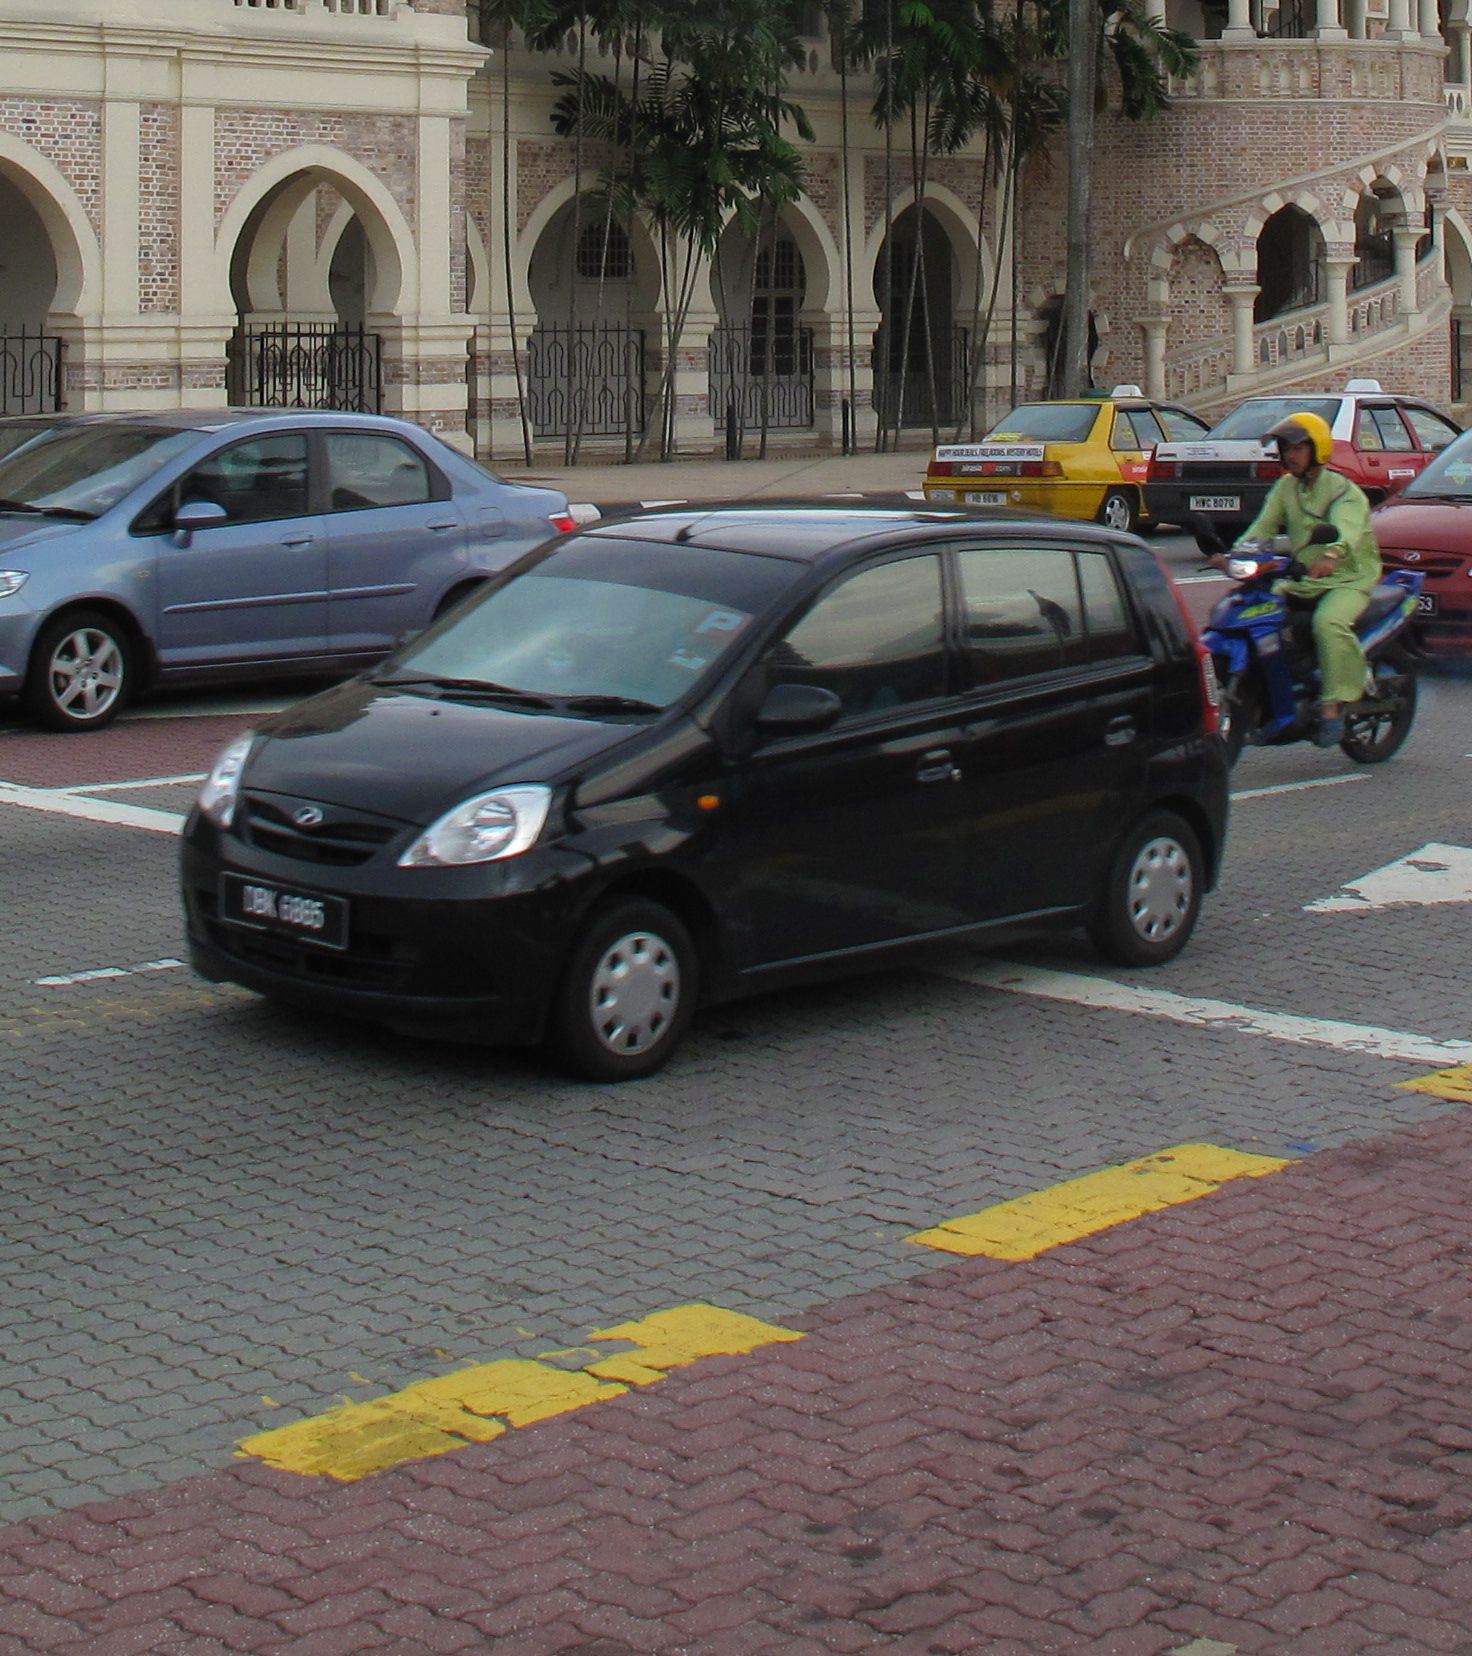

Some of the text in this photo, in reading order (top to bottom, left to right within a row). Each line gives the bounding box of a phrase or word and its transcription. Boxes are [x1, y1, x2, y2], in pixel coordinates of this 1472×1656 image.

[1195, 498, 1235, 508] HWC 8070
[695, 609, 745, 634] P
